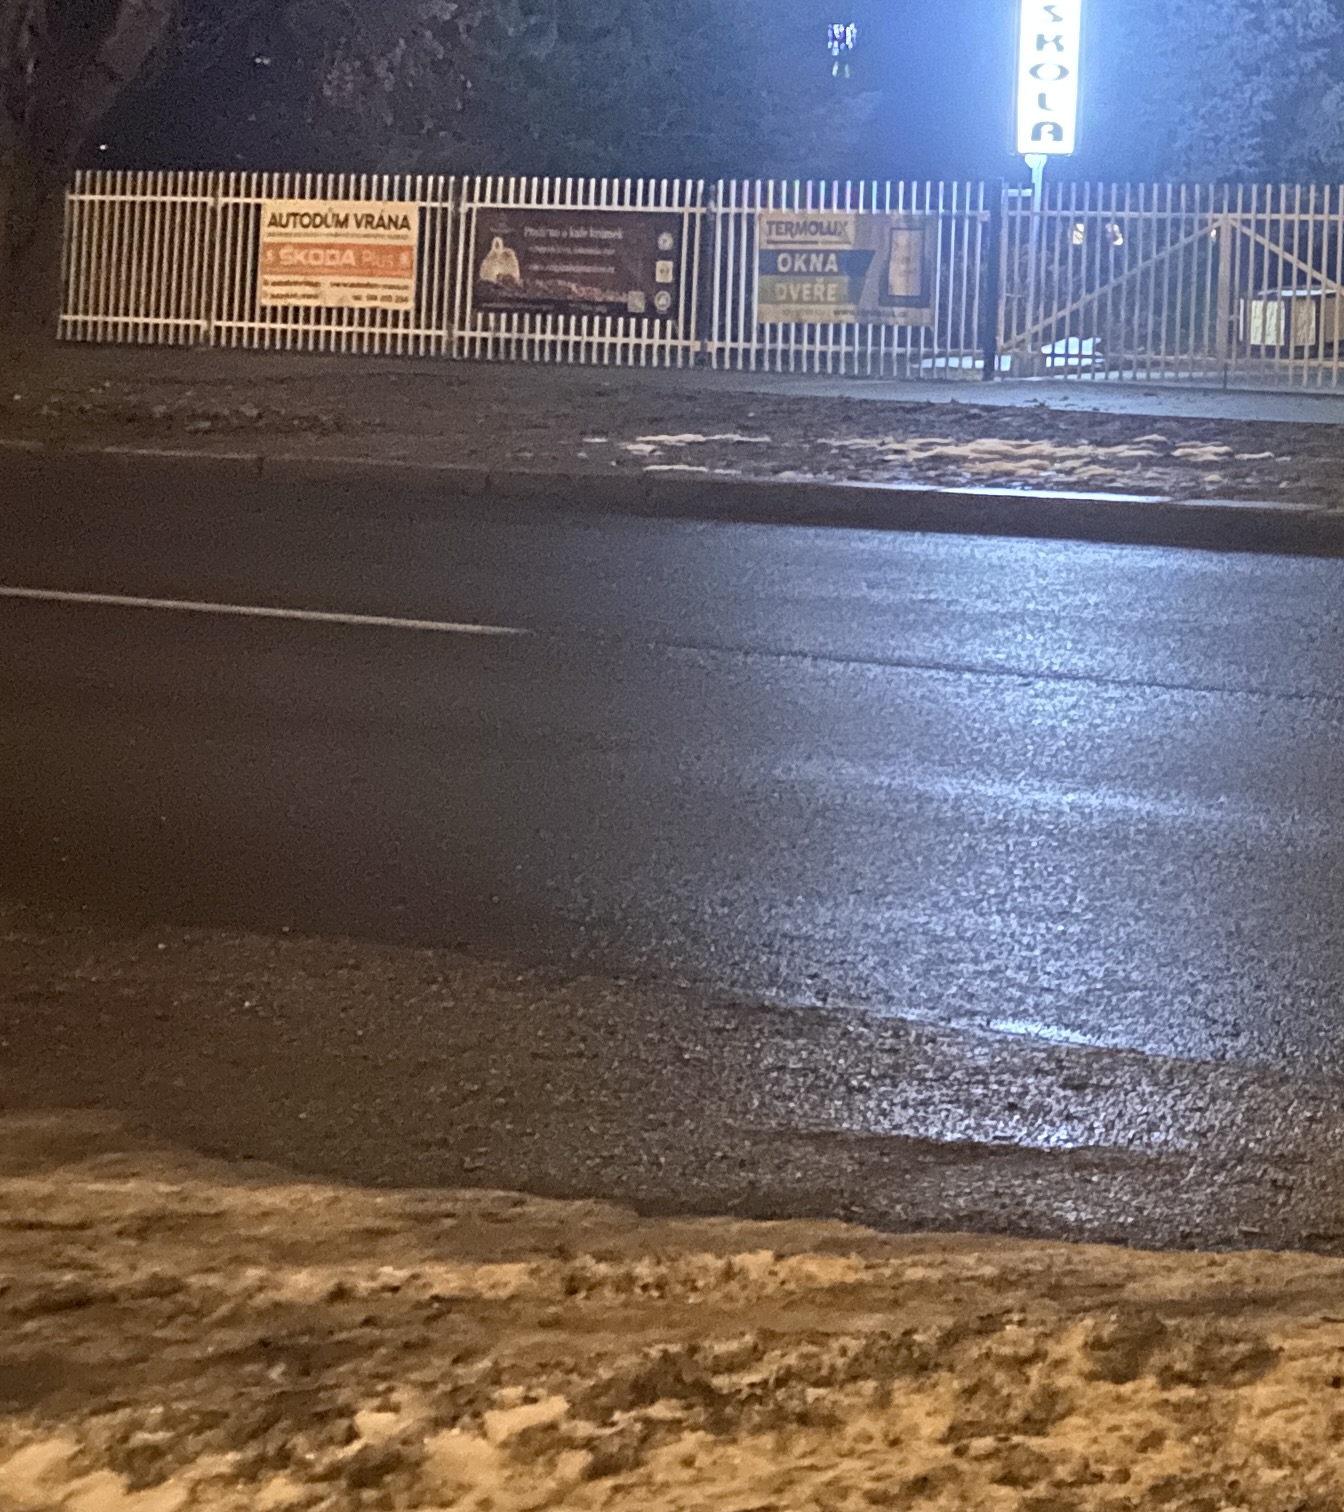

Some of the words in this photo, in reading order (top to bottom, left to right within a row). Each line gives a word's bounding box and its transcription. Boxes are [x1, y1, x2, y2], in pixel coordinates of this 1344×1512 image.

[267, 207, 350, 229] AUTODŮM
[353, 209, 411, 231] VRÁNA
[766, 220, 849, 237] TERMOLUX
[278, 244, 357, 266] ŠKODA
[776, 253, 839, 273] OKNA
[775, 278, 839, 302] DVEŘE
